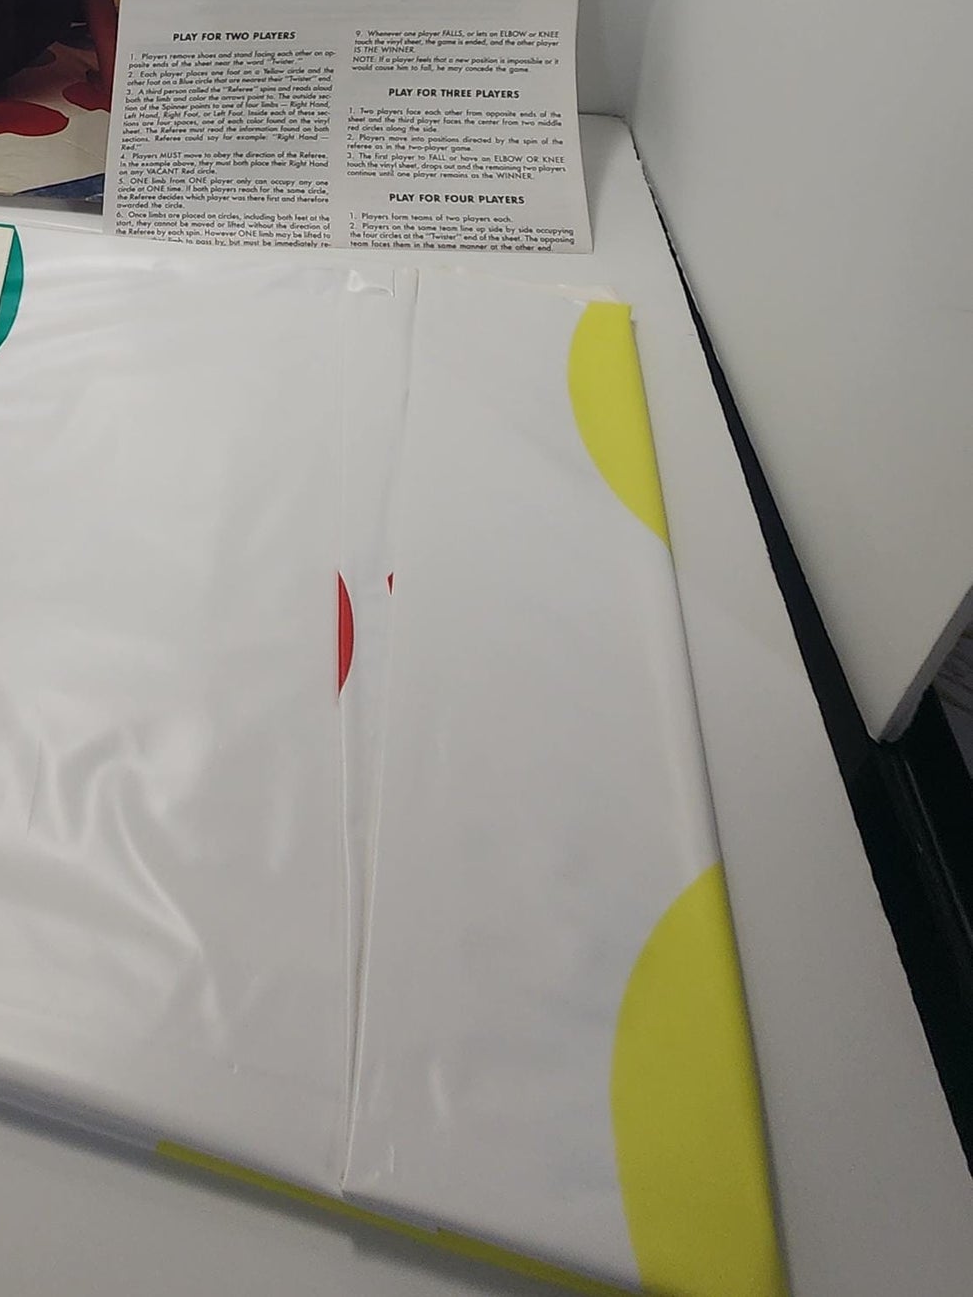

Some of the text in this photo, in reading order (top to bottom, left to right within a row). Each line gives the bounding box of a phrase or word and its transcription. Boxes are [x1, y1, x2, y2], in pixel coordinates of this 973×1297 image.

[173, 31, 295, 40] PLAY FOR TWO PLAYERS
[389, 88, 519, 98] PLAY FOR THREE PLAYERS
[389, 193, 524, 203] PLAY FOR FOUR PLAYERS
[361, 212, 389, 221] Players
[463, 215, 491, 224] players
